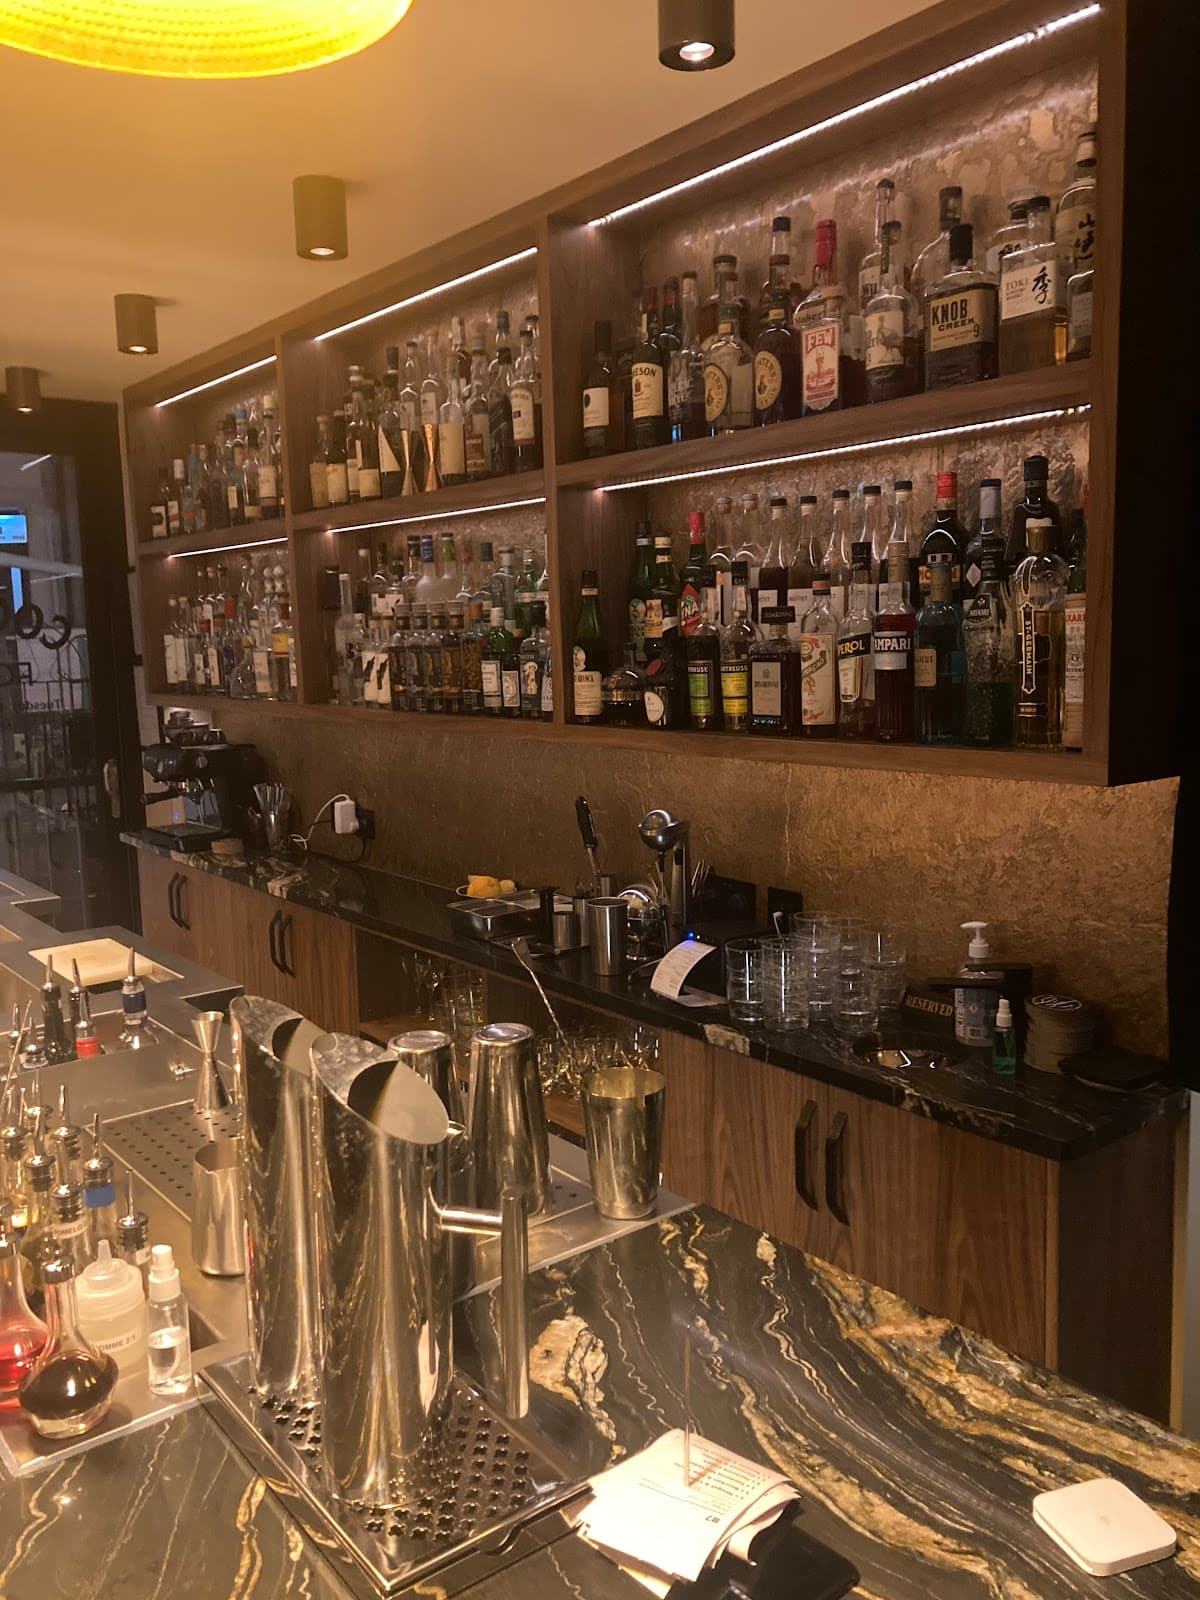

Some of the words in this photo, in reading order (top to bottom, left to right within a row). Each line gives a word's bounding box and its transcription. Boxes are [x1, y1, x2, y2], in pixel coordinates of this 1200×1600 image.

[1032, 265, 1052, 305] 季
[931, 298, 968, 327] KNOB
[938, 316, 975, 332] CREEK
[973, 323, 980, 338] 9
[807, 327, 834, 353] FEW
[905, 995, 953, 1017] RESERVED
[94, 1339, 124, 1352] OMME
